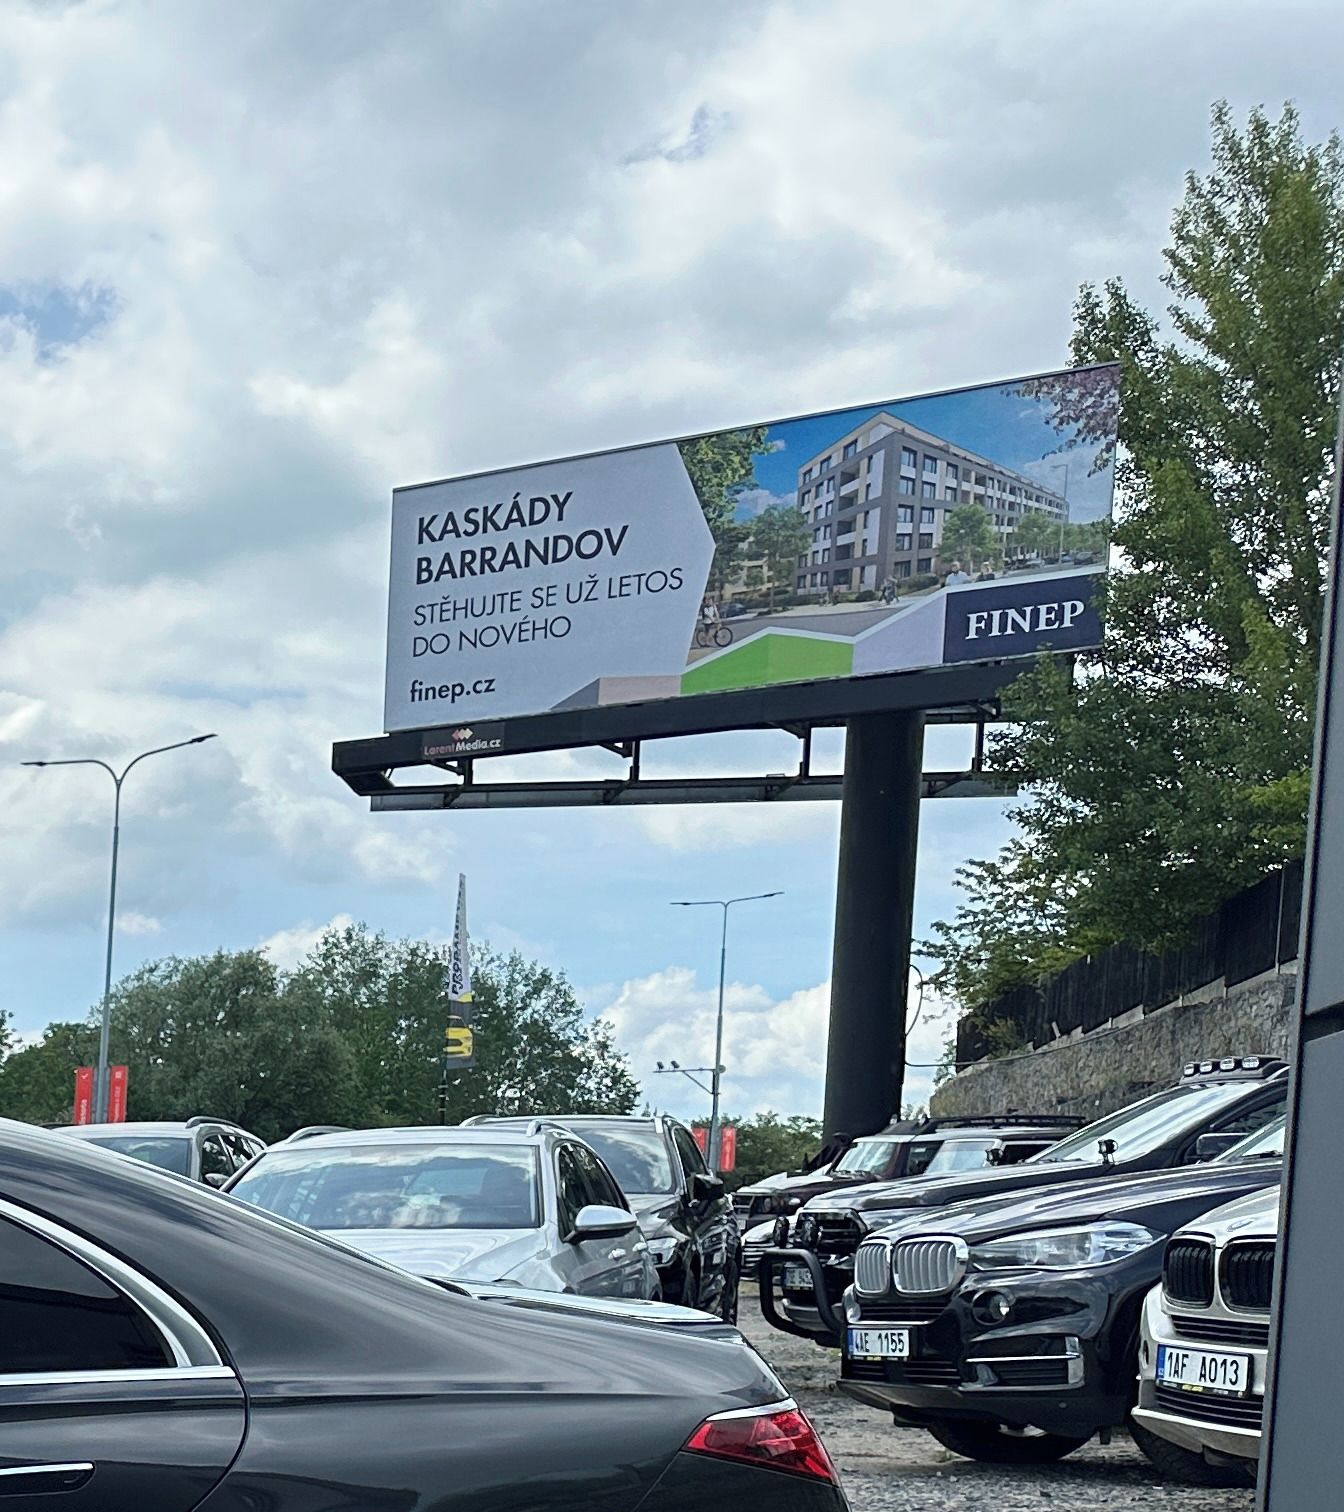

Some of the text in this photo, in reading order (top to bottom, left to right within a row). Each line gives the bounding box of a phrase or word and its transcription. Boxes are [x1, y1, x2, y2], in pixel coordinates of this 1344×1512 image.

[417, 492, 573, 544] KASKÁDY
[416, 525, 629, 585] BARRANDOV
[414, 568, 683, 626] STĚHUJTE SE UŽ LETOS
[413, 615, 571, 657] DO NOVÉHO
[965, 600, 1085, 640] FINEP
[410, 679, 496, 703] finep.cz
[878, 1332, 904, 1352] 1155
[1168, 1352, 1239, 1385] 1AF A013
